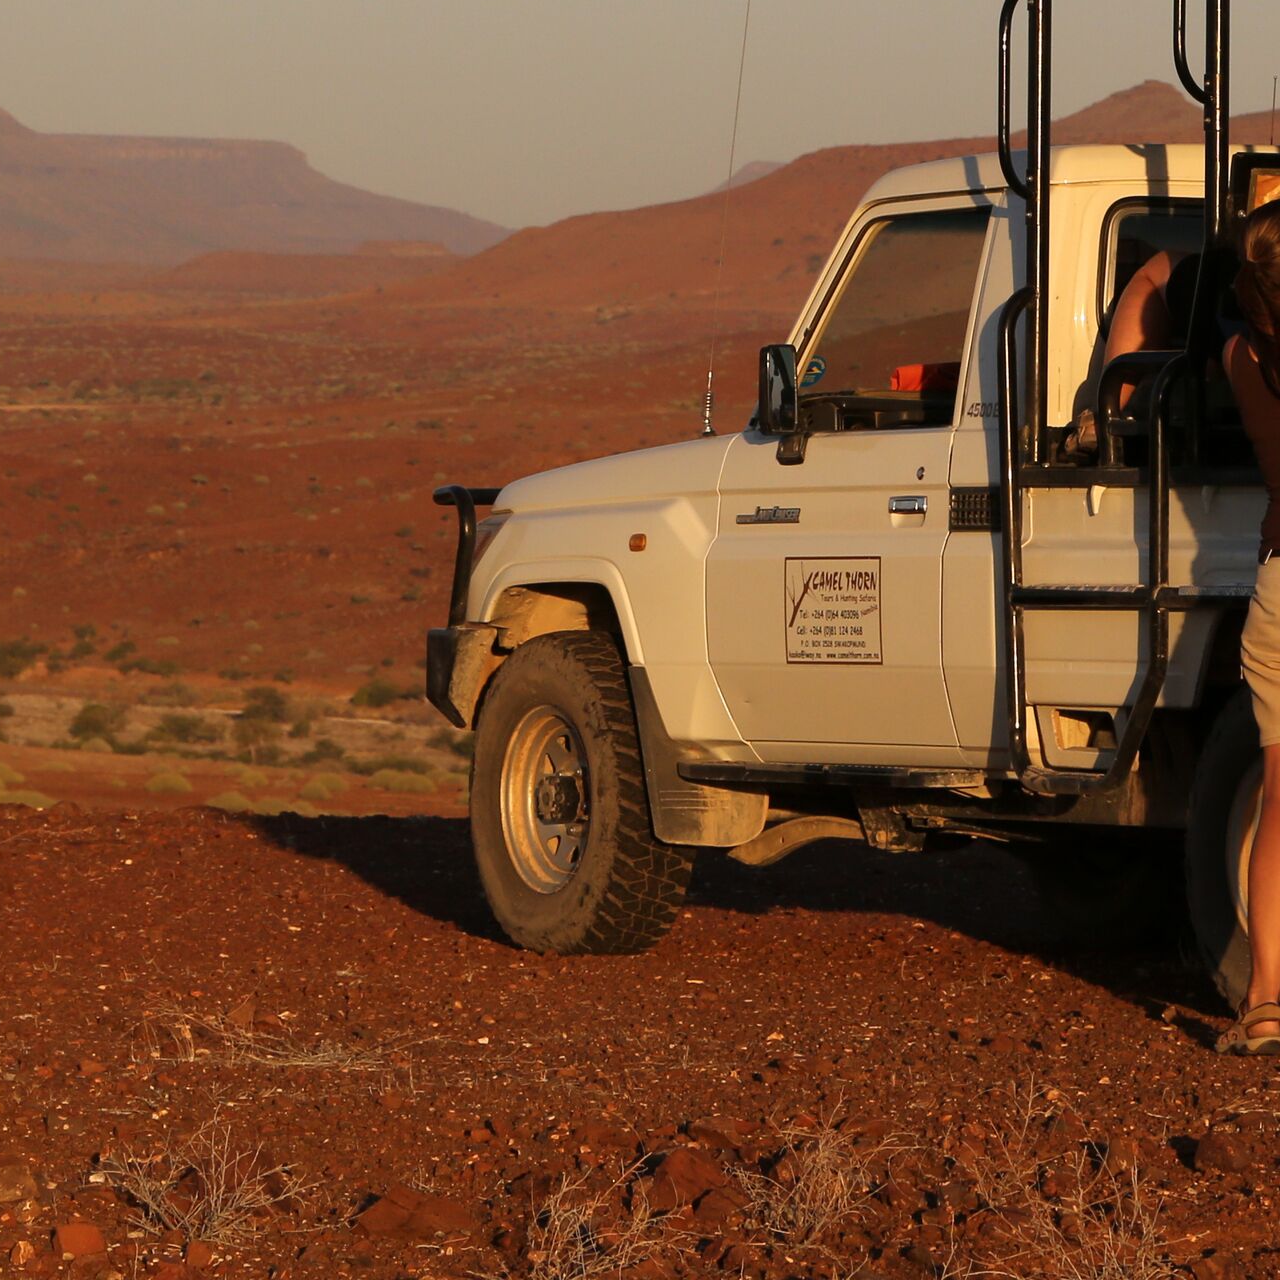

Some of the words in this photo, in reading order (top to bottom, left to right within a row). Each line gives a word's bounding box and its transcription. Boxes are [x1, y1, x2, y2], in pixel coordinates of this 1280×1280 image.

[812, 571, 843, 591] CAMEL
[845, 571, 878, 591] THORN
[821, 594, 833, 602] Tours
[840, 594, 858, 604] Hunting
[859, 594, 877, 602] Safaris
[811, 610, 823, 619] +264
[825, 610, 839, 621] (0)64
[809, 626, 822, 635] +264
[823, 626, 837, 637] (0)81
[839, 626, 848, 635] 124
[850, 626, 863, 635] 2468
